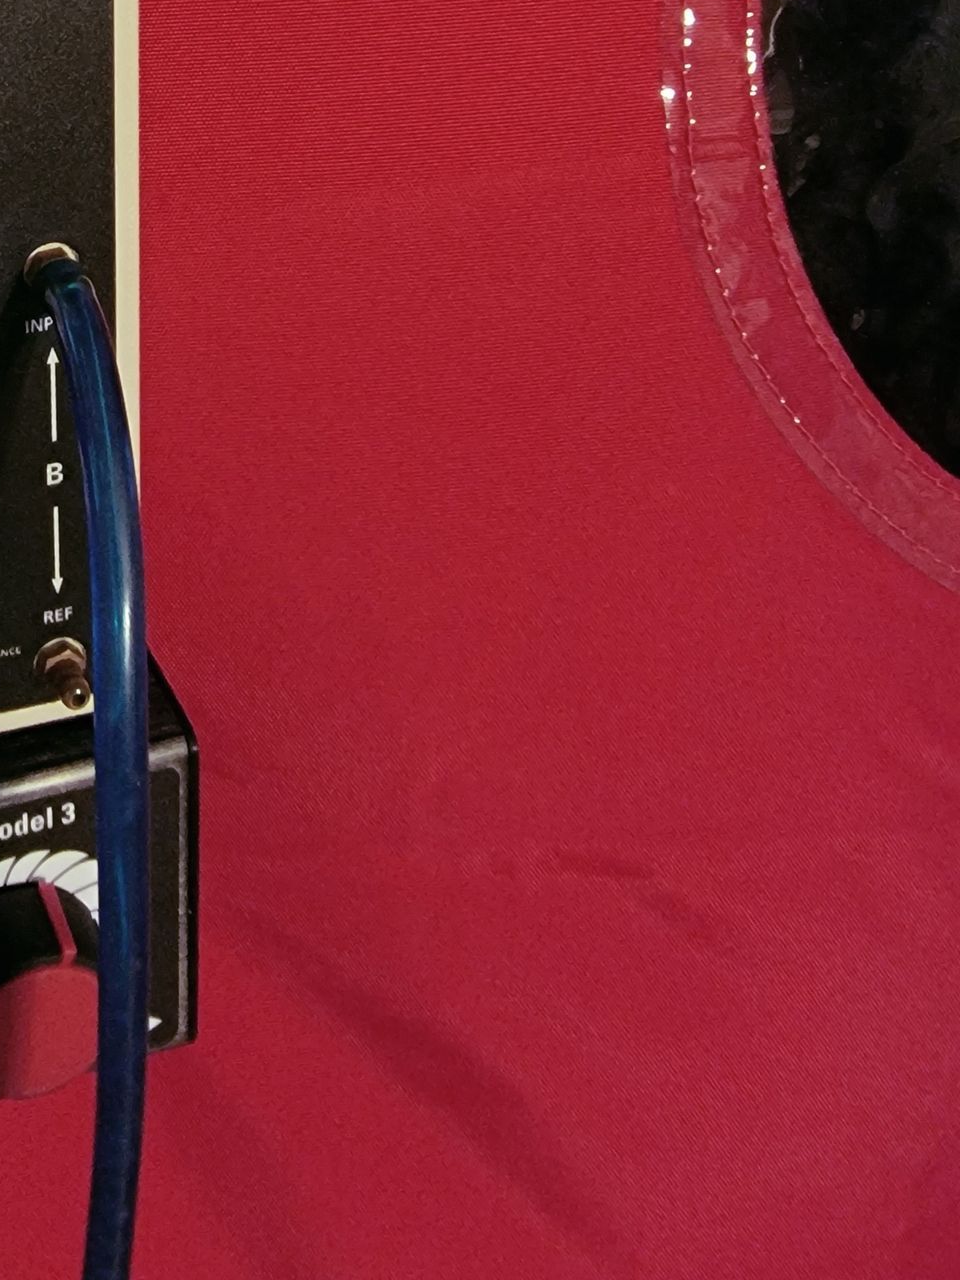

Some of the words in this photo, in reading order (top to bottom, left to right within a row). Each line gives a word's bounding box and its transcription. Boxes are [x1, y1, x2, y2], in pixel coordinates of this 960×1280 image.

[25, 315, 54, 334] INP
[46, 462, 64, 486] B
[43, 606, 73, 625] REF
[60, 801, 77, 826] 3
